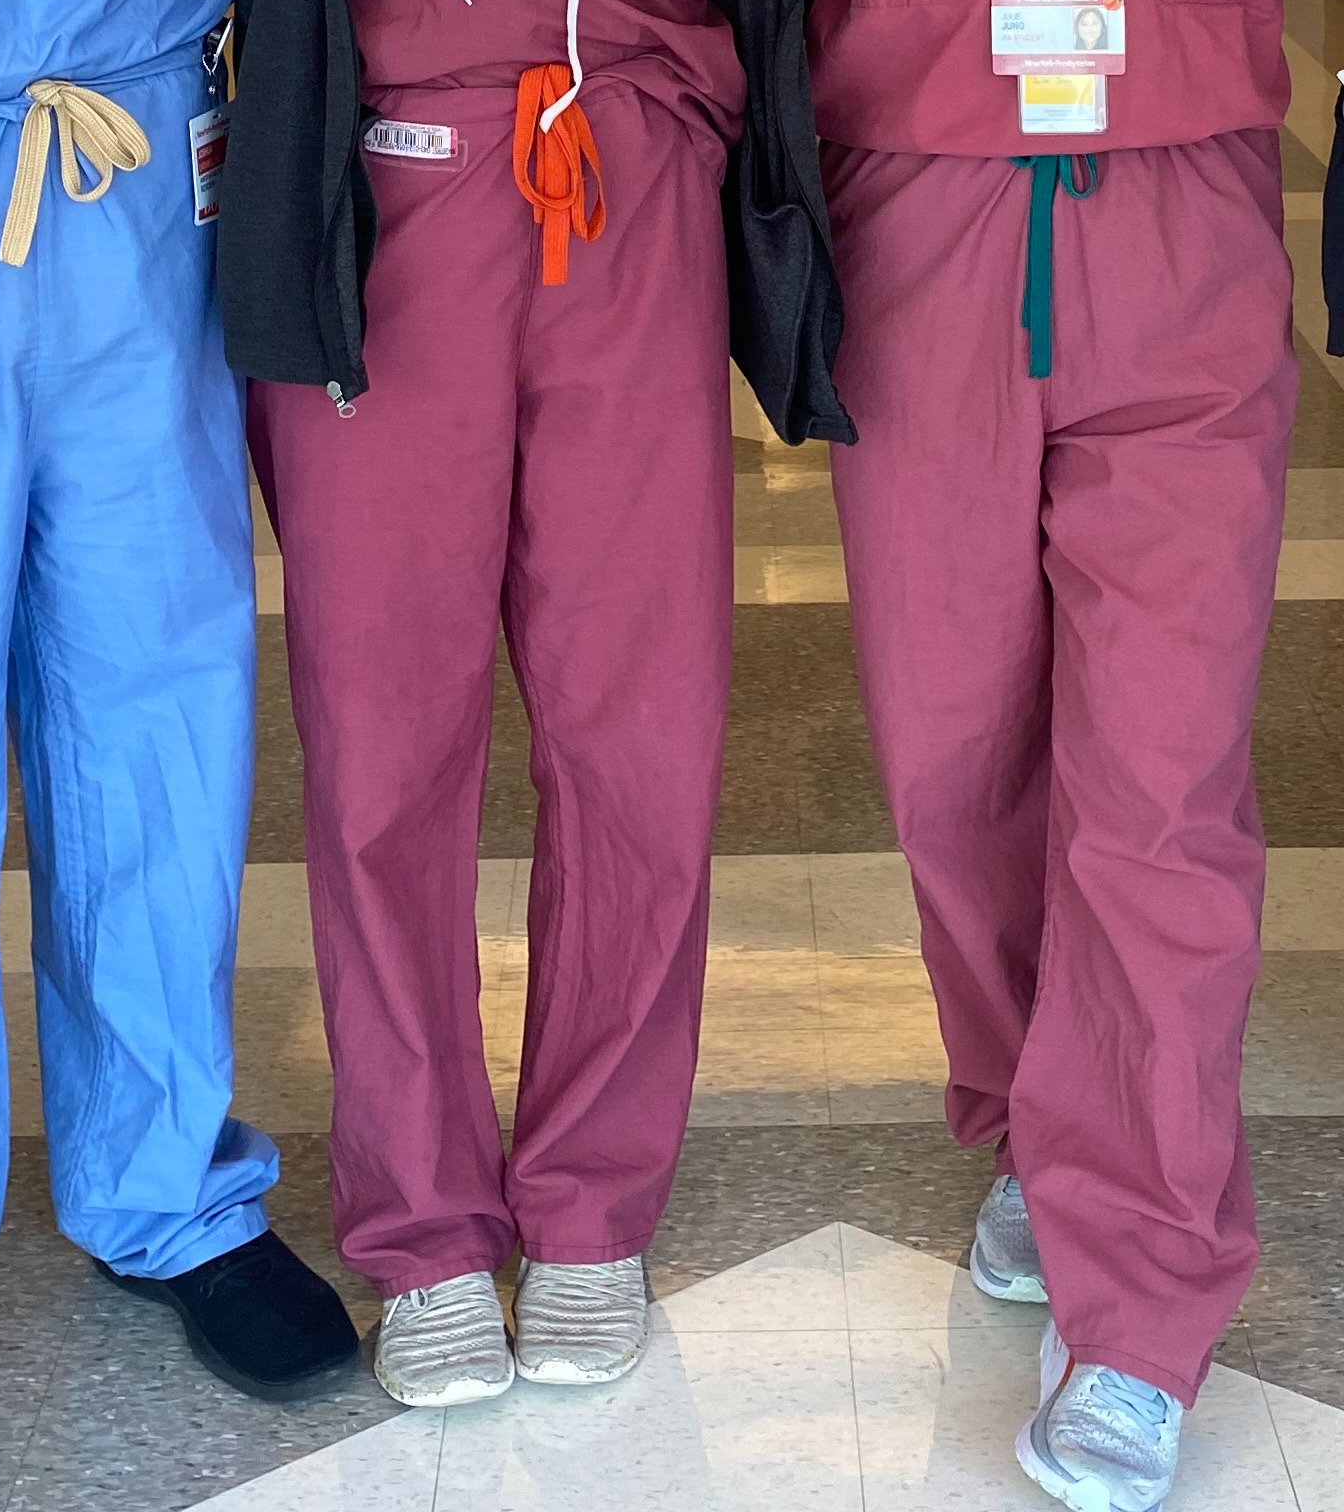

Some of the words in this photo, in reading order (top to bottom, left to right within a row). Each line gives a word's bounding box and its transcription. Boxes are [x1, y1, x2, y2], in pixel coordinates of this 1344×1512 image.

[1001, 12, 1021, 21] JULIE
[1001, 21, 1025, 31] JUNG
[1014, 33, 1045, 42] STUDENT
[1024, 59, 1096, 69] NewYork-Presbyterian
